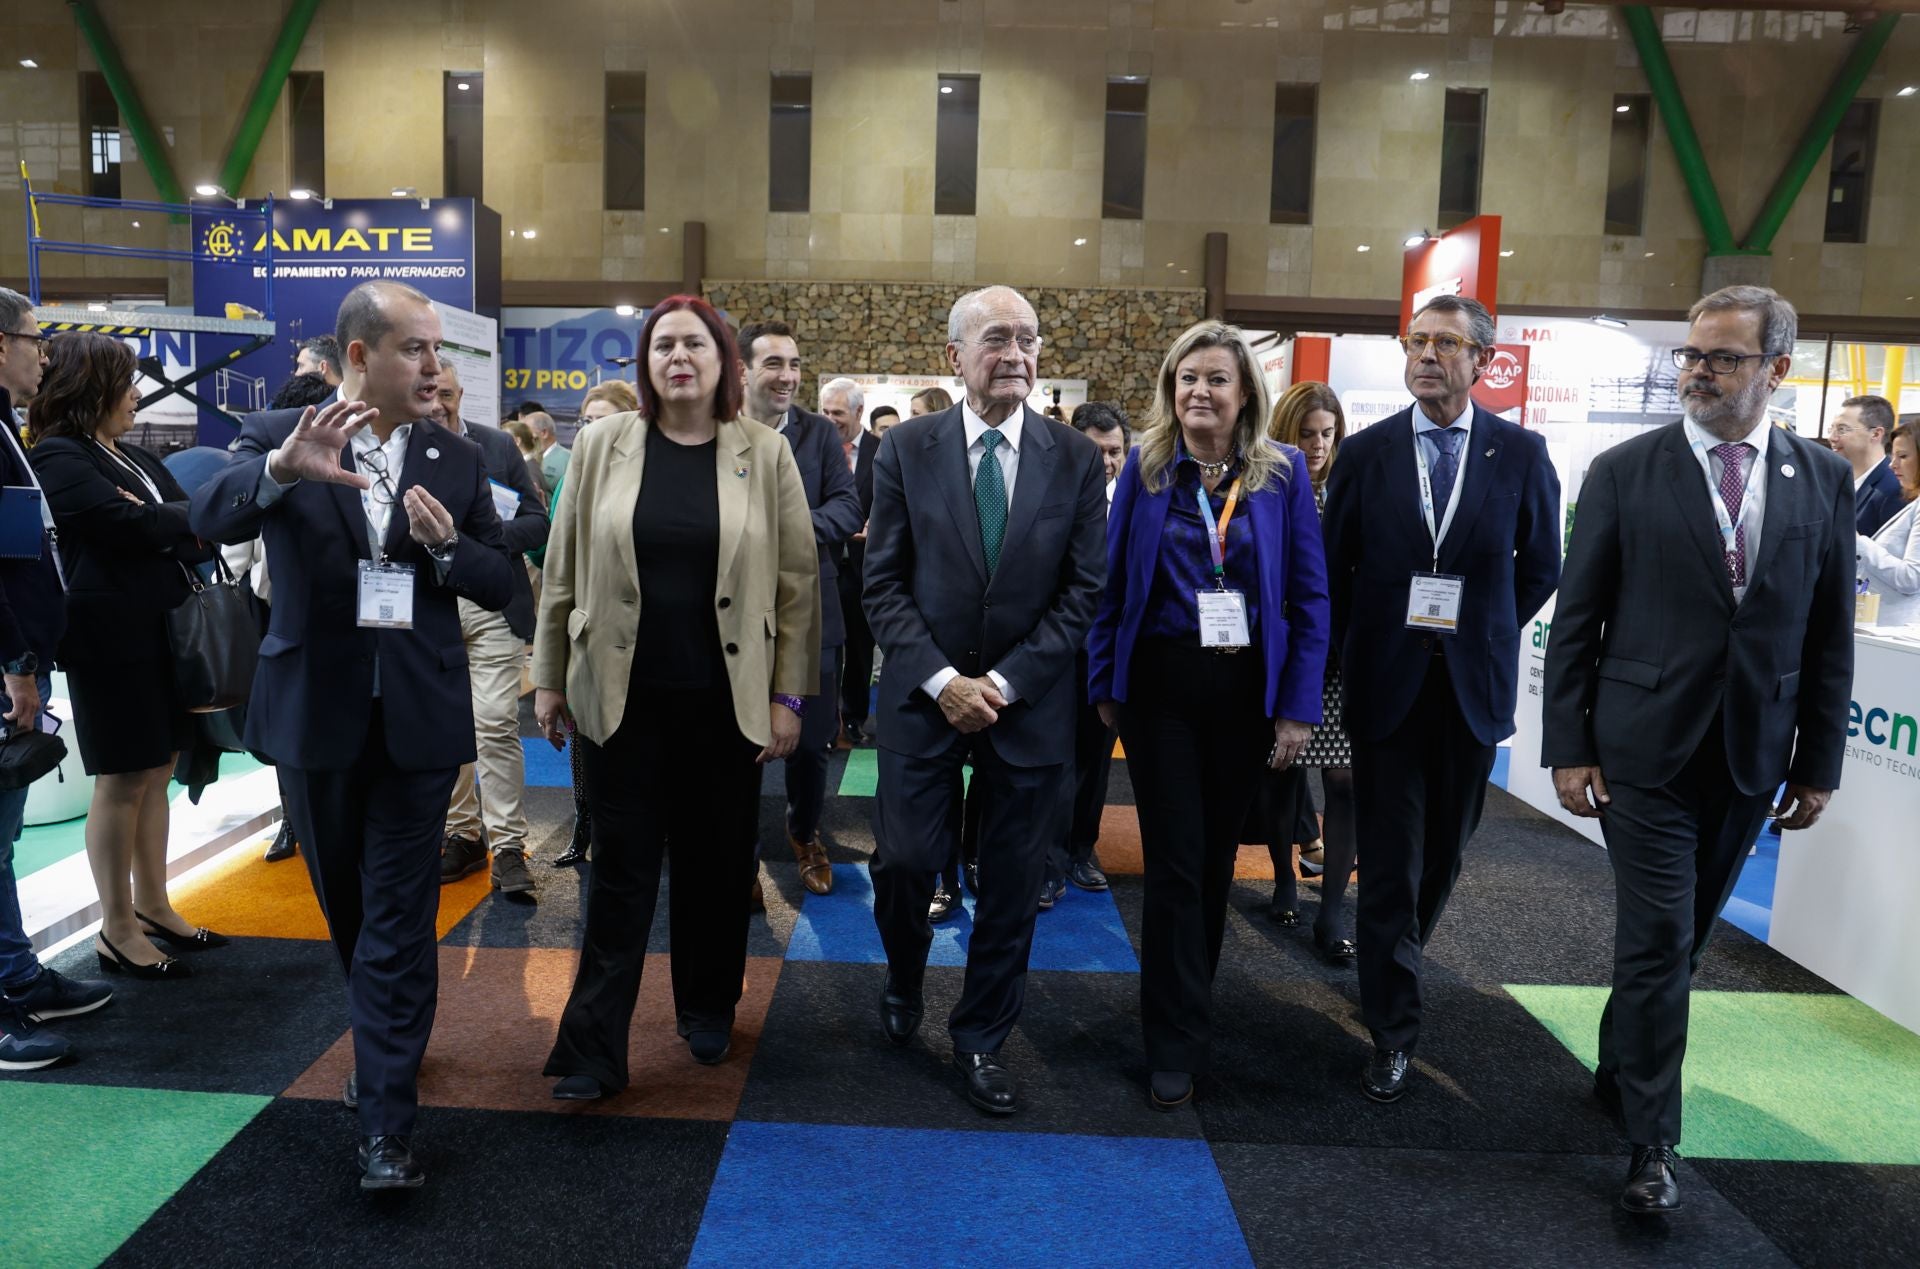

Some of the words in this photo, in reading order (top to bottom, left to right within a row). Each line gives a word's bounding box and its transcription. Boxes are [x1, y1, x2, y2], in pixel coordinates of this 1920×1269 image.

[253, 228, 434, 252] AMATE
[350, 266, 380, 278] PARA
[383, 266, 466, 278] INVERNADERO
[504, 328, 642, 371] TIZO
[505, 368, 532, 389] 37
[536, 369, 587, 390] PRO
[1532, 407, 1547, 424] NO
